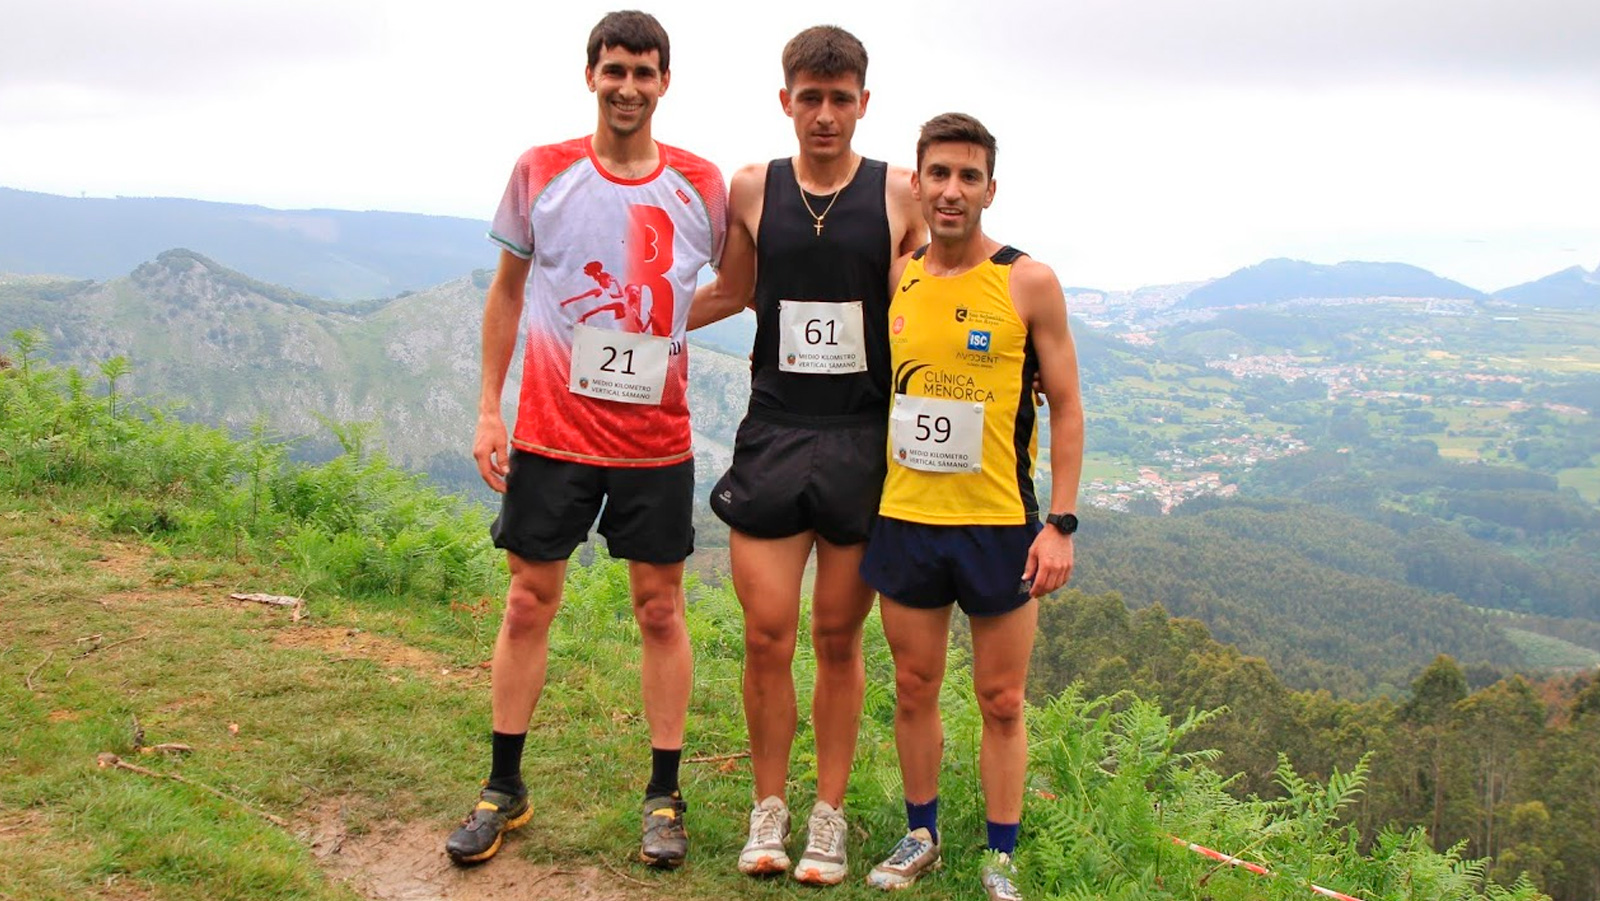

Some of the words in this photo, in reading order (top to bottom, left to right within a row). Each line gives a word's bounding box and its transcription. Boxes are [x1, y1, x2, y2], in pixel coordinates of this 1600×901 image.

[804, 318, 839, 346] 61
[970, 334, 988, 347] ISC
[599, 345, 636, 376] 21
[592, 378, 613, 388] MEDIO
[614, 382, 652, 393] KILOMETRO
[924, 369, 976, 388] CLÍNICA
[591, 386, 620, 397] VERTICAL
[923, 383, 995, 402] MENORCA
[914, 413, 952, 444] 59
[909, 448, 929, 457] MEDIO
[930, 452, 969, 461] KILOMETRO
[909, 457, 935, 467] VERTICAL
